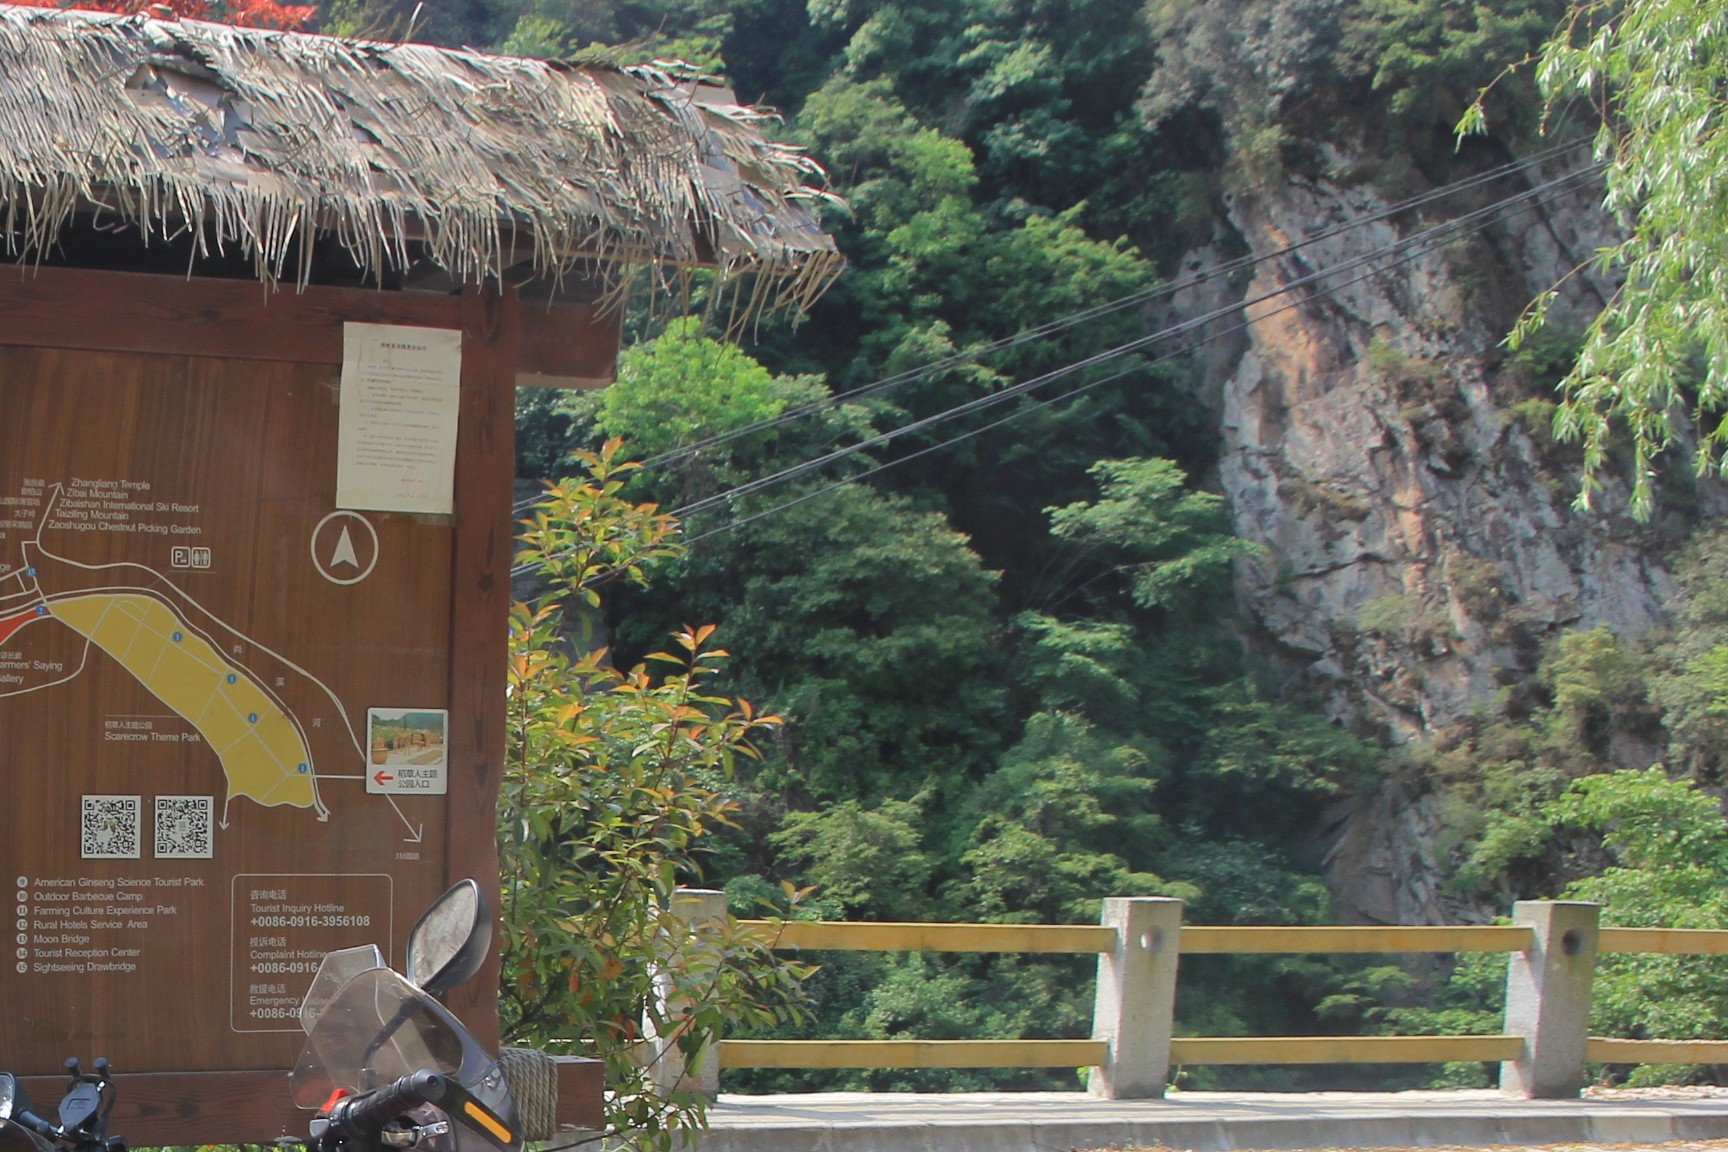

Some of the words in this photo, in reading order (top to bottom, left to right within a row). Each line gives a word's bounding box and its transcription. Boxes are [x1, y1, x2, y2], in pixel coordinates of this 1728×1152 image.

[70, 478, 115, 490] Zhangliang
[120, 480, 150, 491] Temple
[66, 489, 87, 499] Zibai
[90, 487, 128, 498] Mountain
[59, 499, 100, 510] Zibaishan
[104, 501, 154, 512] International
[156, 502, 169, 511] Ski
[172, 503, 199, 512] Resort
[55, 509, 88, 521] Taiziling
[91, 510, 128, 522] Mountain
[48, 520, 96, 532] Zaoshugou
[98, 522, 136, 531] Chestnut
[138, 523, 168, 535] Picking
[170, 525, 201, 534] Garden
[397, 769, 438, 780] 稻草人主题
[397, 779, 430, 789] 公园入口
[34, 878, 75, 886] American
[78, 878, 114, 888] Ginseng
[117, 878, 151, 886] Science
[154, 878, 181, 886] Tourist
[184, 878, 204, 886] Park
[34, 892, 69, 900] Outdoor
[72, 892, 113, 900] Barbecue
[117, 892, 142, 902] Camp
[34, 906, 70, 917] Farming
[73, 906, 104, 914] Culture
[107, 906, 154, 916] Experience
[157, 905, 176, 914] Park
[251, 904, 280, 912] Tourist
[283, 904, 312, 914] Inquiry
[314, 904, 344, 912] Hotline
[34, 921, 57, 929] Rural
[60, 920, 87, 929] Hotels
[91, 920, 122, 928] Service
[127, 920, 148, 928] Area
[251, 916, 370, 926] +0086-0916-3956108
[34, 935, 58, 943] Moon
[62, 934, 89, 944] Bridge
[34, 949, 62, 957] Tourist
[65, 948, 108, 958] Reception
[111, 948, 140, 956] Center
[250, 950, 294, 960] Complaint
[34, 962, 84, 973] Sightseeing
[87, 962, 136, 972] Drawbridge
[250, 996, 300, 1006] Emergency
